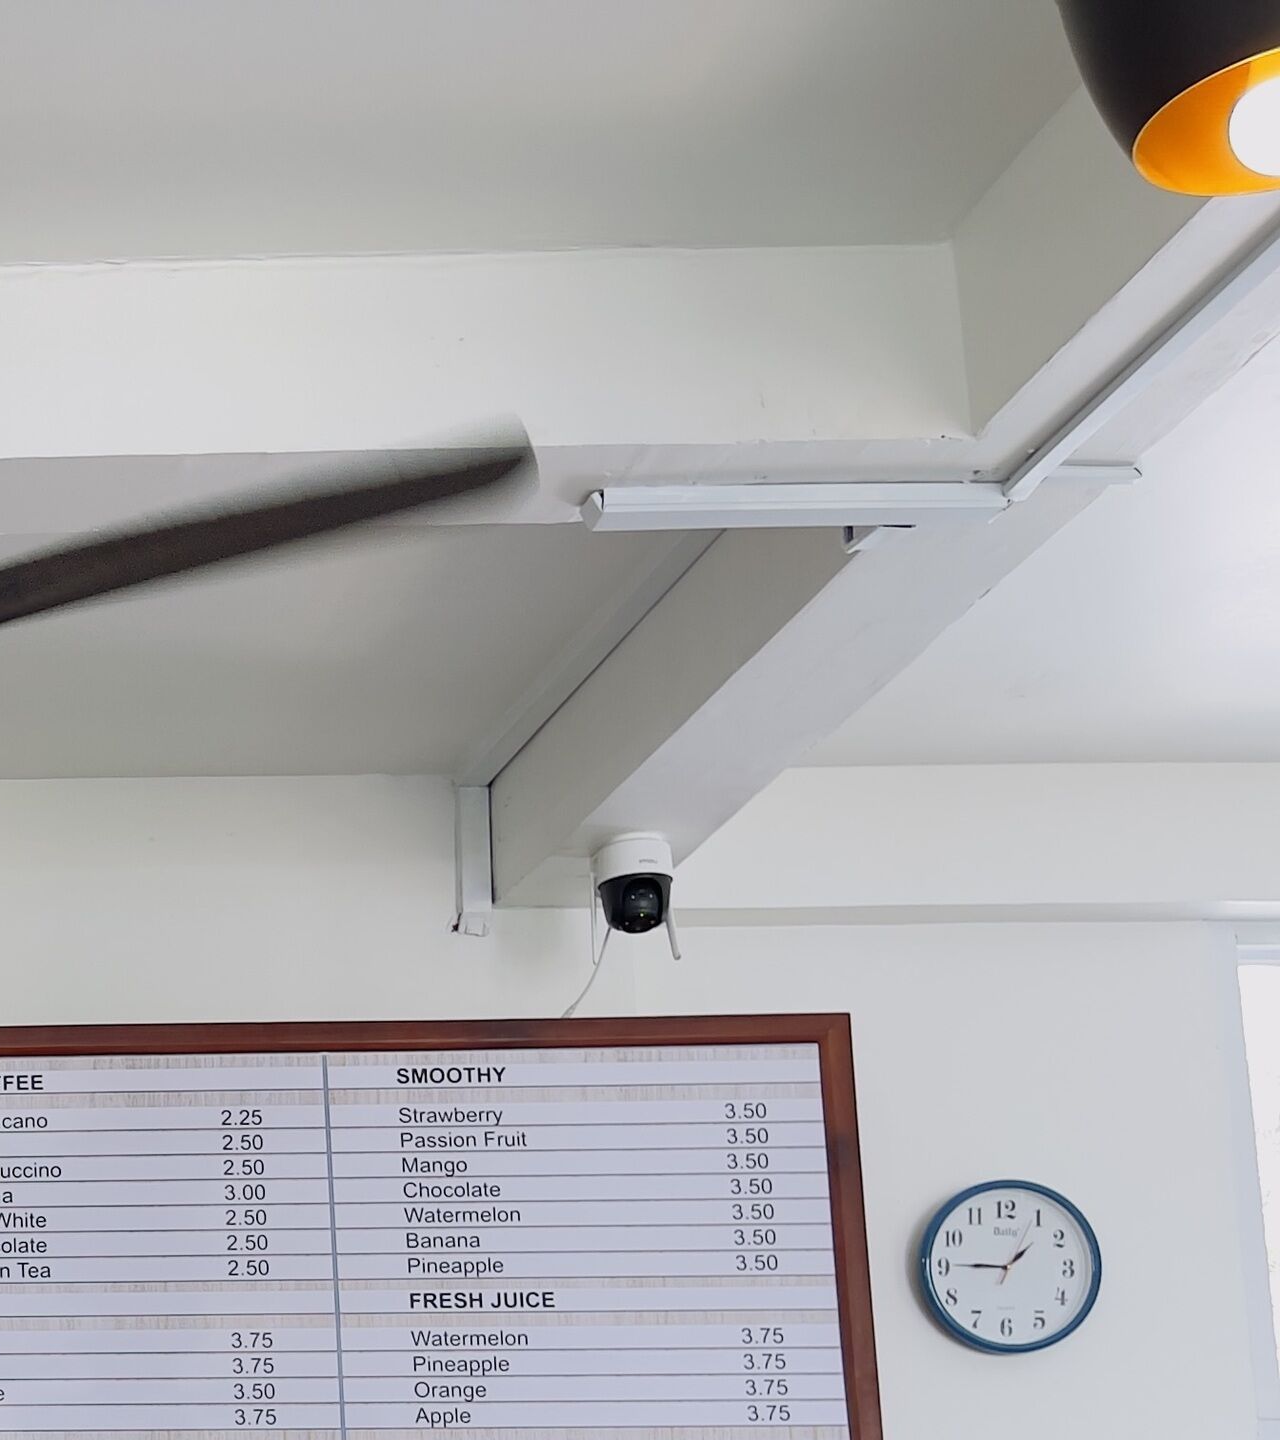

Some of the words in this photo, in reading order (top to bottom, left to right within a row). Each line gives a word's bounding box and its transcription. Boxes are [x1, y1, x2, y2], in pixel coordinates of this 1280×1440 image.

[396, 1066, 506, 1085] SMOOTHY
[221, 1109, 263, 1126] 2.25
[398, 1107, 503, 1127] Strawberry
[725, 1102, 767, 1119] 3.50
[222, 1134, 264, 1151] 2.50
[400, 1132, 477, 1149] Passion
[484, 1131, 527, 1147] Fruit
[727, 1127, 769, 1144] 3.50
[223, 1159, 265, 1176] 2.50
[402, 1157, 468, 1177] Mango
[727, 1152, 769, 1170] 3.50
[224, 1184, 266, 1201] 3.00
[403, 1181, 501, 1199] Chocolate
[730, 1178, 773, 1195] 3.50
[225, 1209, 267, 1226] 2.50
[403, 1206, 521, 1224] Watermelon
[732, 1203, 775, 1220] 3.50
[968, 1207, 982, 1226] 11
[996, 1200, 1016, 1220] 12
[1035, 1209, 1042, 1227] 1
[226, 1234, 268, 1251] 2.50
[406, 1232, 481, 1249] Banana
[734, 1229, 776, 1246] 3.50
[945, 1230, 963, 1248] 10
[1053, 1229, 1065, 1248] 2
[16, 1262, 51, 1279] Tea
[227, 1259, 270, 1276] 2.50
[407, 1257, 504, 1277] Pineapple
[735, 1254, 778, 1271] 3.50
[937, 1258, 950, 1277] 9
[1062, 1259, 1075, 1278] 3
[409, 1292, 483, 1309] FRESH
[490, 1291, 556, 1309] JUICE
[945, 1288, 958, 1306] 8
[1054, 1287, 1068, 1306] 4
[971, 1310, 982, 1329] 7
[1000, 1318, 1013, 1337] 6
[1033, 1310, 1046, 1329] 5
[231, 1332, 273, 1349] 3.75
[410, 1330, 529, 1347] Watermelon
[741, 1327, 784, 1344] 3.75
[232, 1357, 274, 1375] 3.75
[413, 1355, 510, 1376] Pineapple
[743, 1353, 786, 1370] 3.75
[233, 1382, 276, 1400] 3.50
[414, 1381, 487, 1402] Orange
[745, 1379, 788, 1395] 3.75
[234, 1408, 277, 1426] 3.75
[415, 1407, 471, 1428] Apple
[748, 1405, 791, 1421] 3.75
